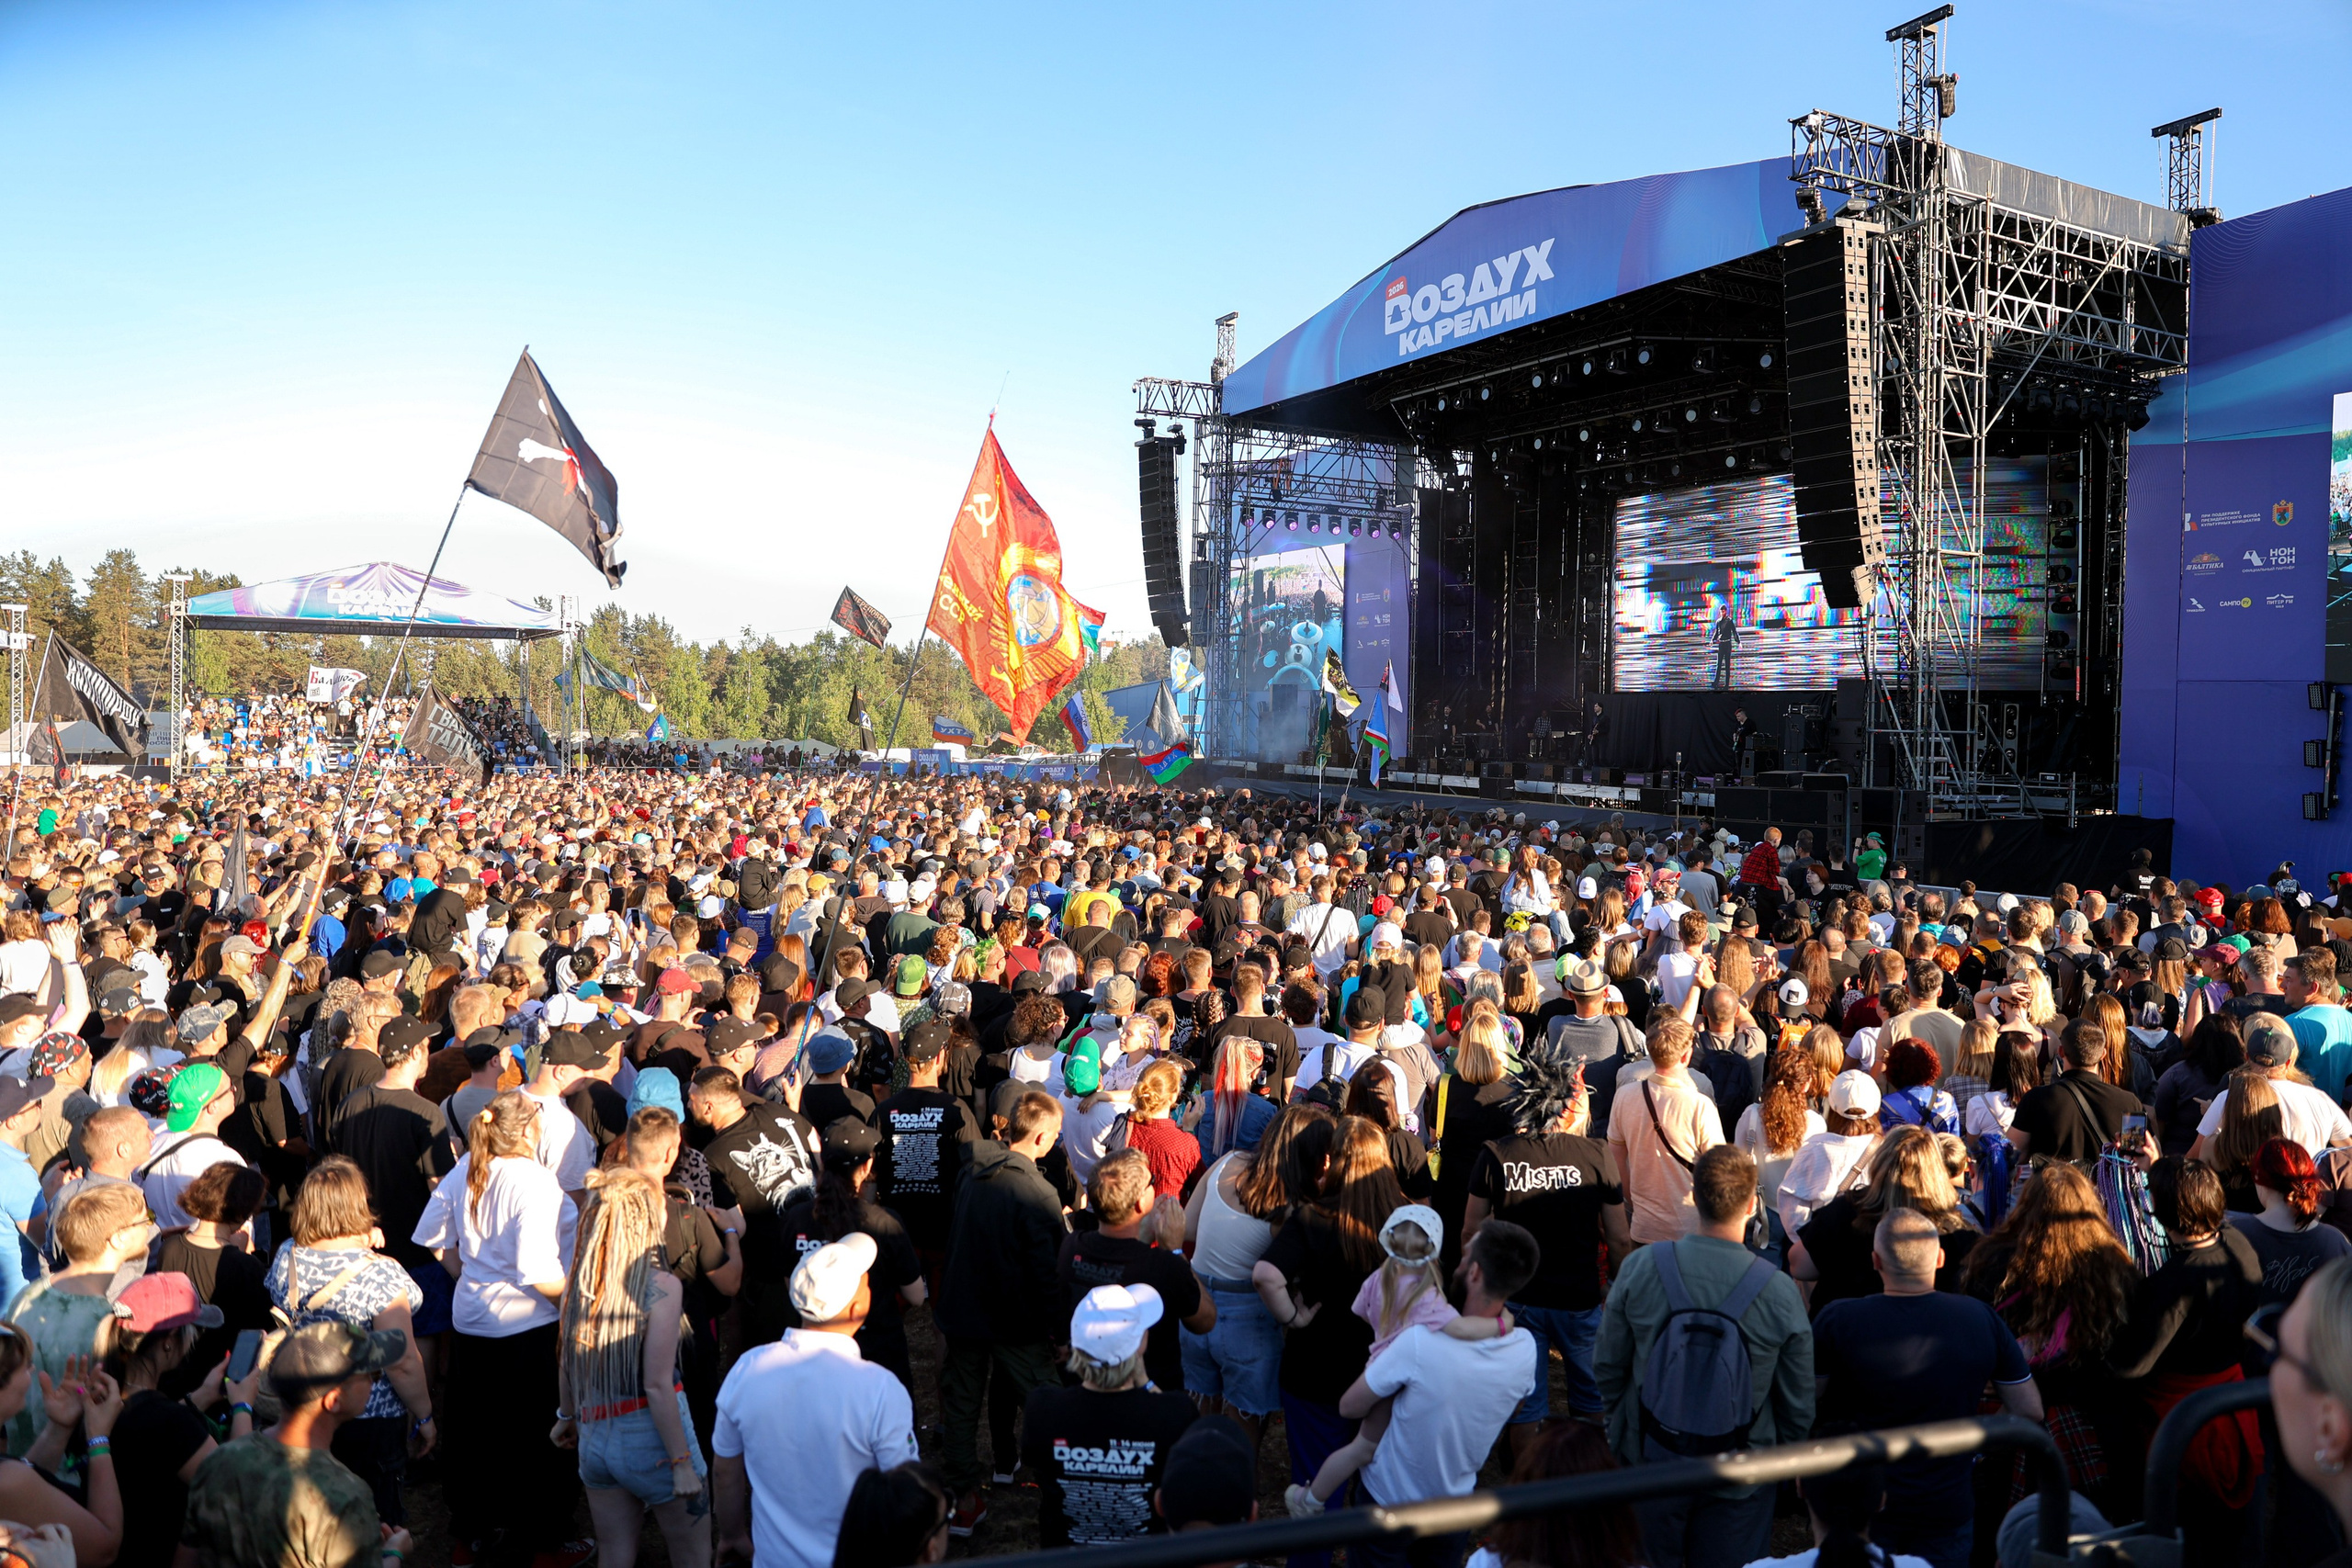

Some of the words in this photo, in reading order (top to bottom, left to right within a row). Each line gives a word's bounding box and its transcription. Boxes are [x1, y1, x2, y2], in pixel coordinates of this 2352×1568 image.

[1385, 238, 1555, 335] ВОЗДУХ
[1387, 280, 1405, 297] 2026
[1399, 288, 1536, 356] КАРЕЛИИ
[2269, 547, 2296, 557] НОН
[2191, 562, 2224, 570] БАЛТИКА
[2269, 556, 2296, 566] ТОН
[889, 1113, 944, 1122] ВОЗДУХ
[1053, 1445, 1155, 1465] ВОЗДУХ
[1063, 1461, 1145, 1474] КАРЕЛИИ
